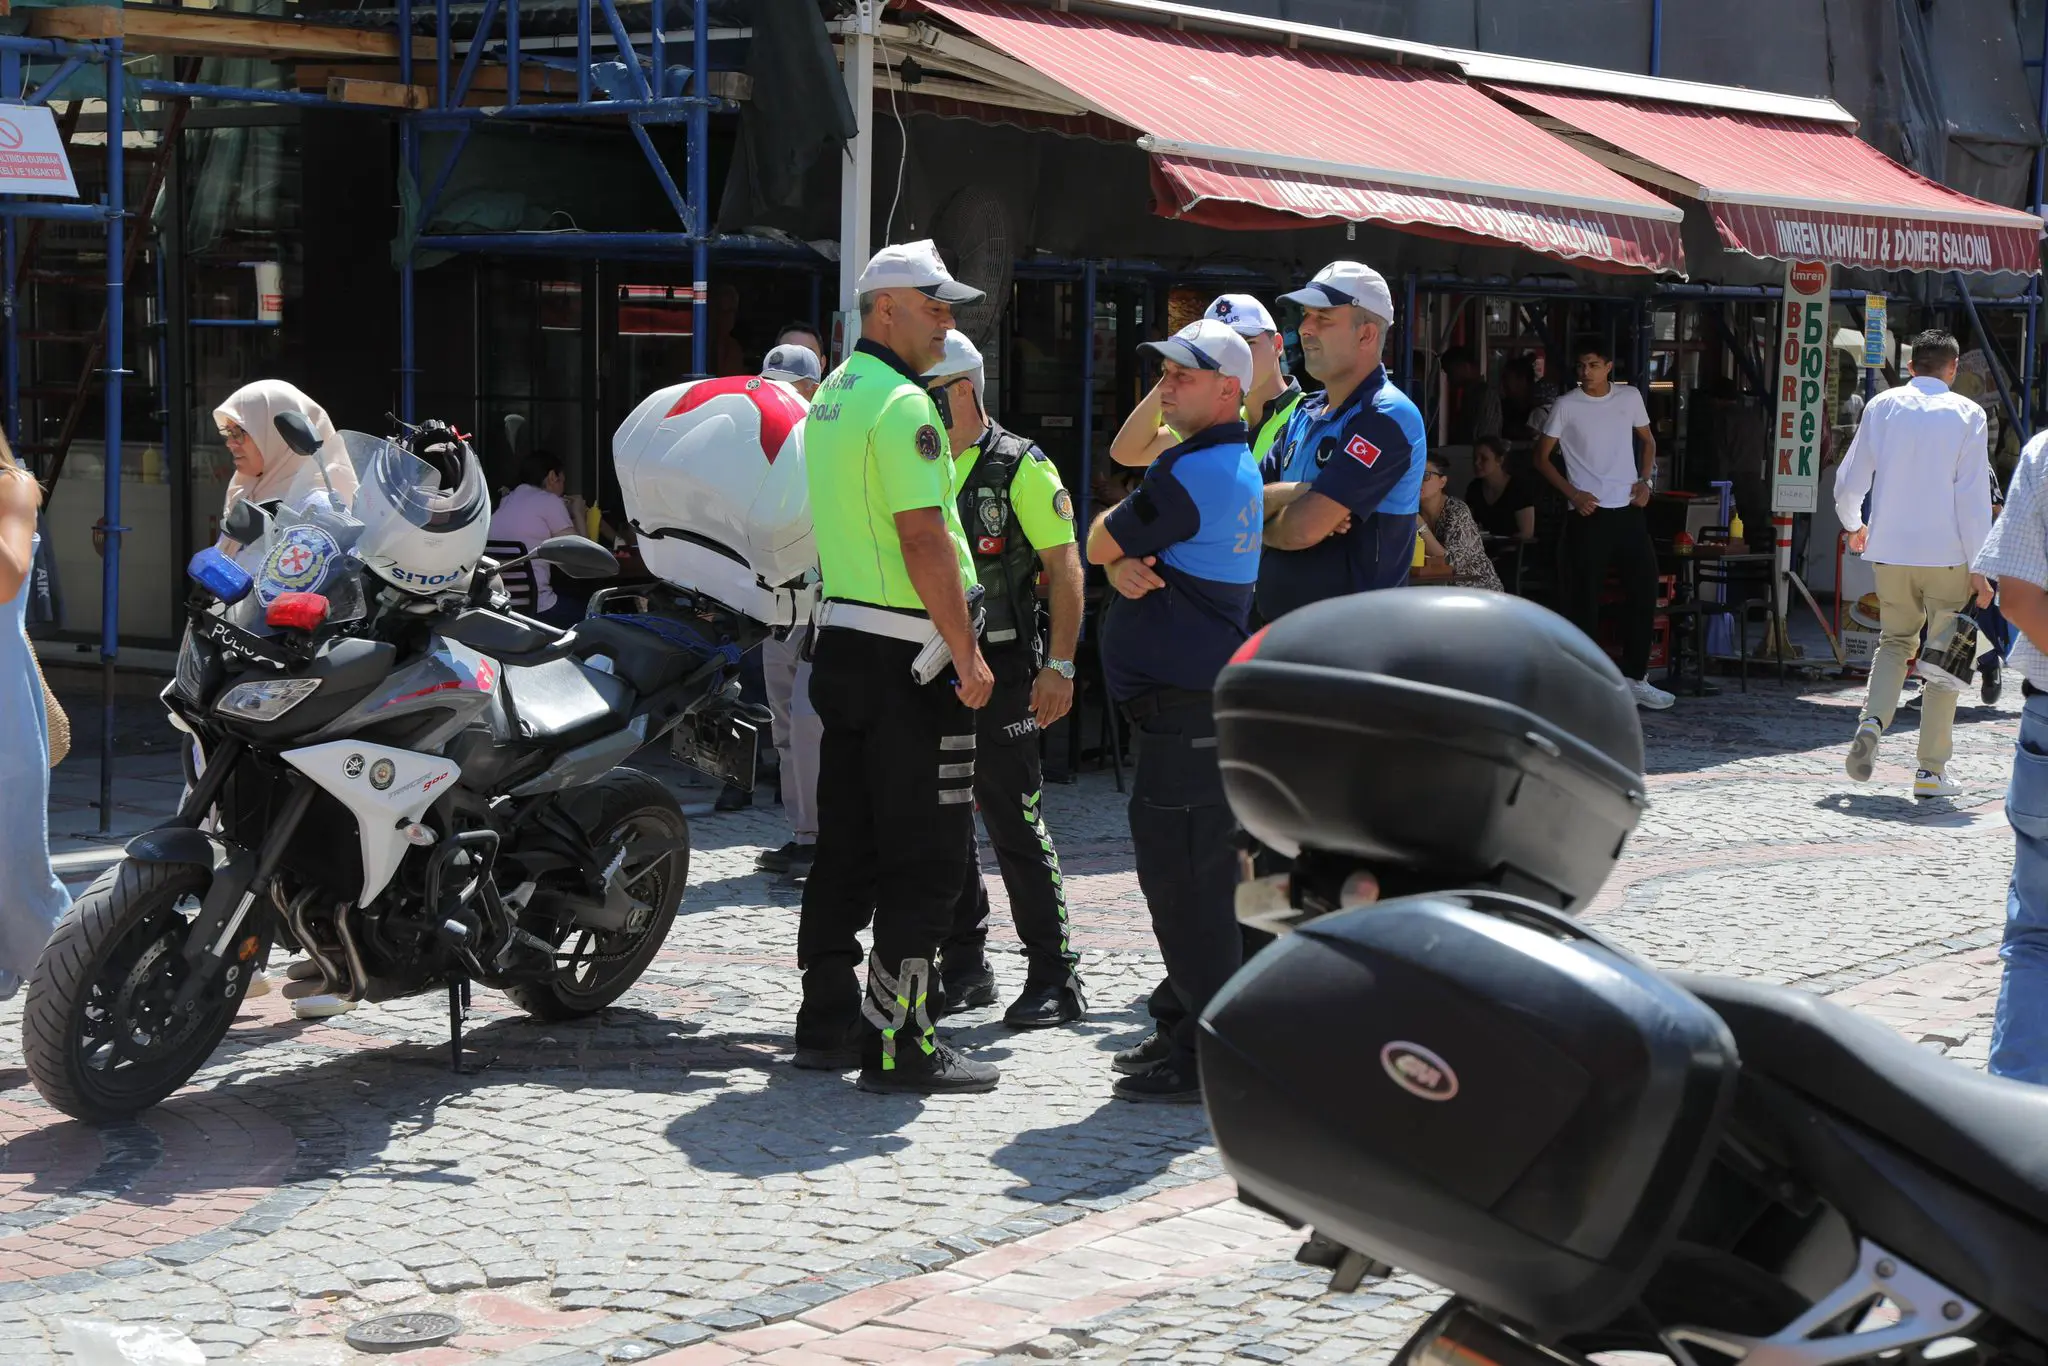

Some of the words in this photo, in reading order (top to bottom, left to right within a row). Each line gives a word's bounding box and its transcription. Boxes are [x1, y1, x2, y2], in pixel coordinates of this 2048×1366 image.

[1263, 169, 1362, 212] İMREN
[1349, 188, 1463, 224] KAHVALTI
[1450, 201, 1480, 227] &
[1467, 197, 1547, 242] DÖNER
[1536, 213, 1612, 257] SALONU
[1773, 210, 1821, 255] İMREN
[1820, 224, 1878, 260] KAHVALTI
[1880, 228, 1890, 261] &
[1894, 220, 1940, 263] DÖNER
[1942, 231, 1992, 266] SALONU
[422, 771, 449, 792] 900
